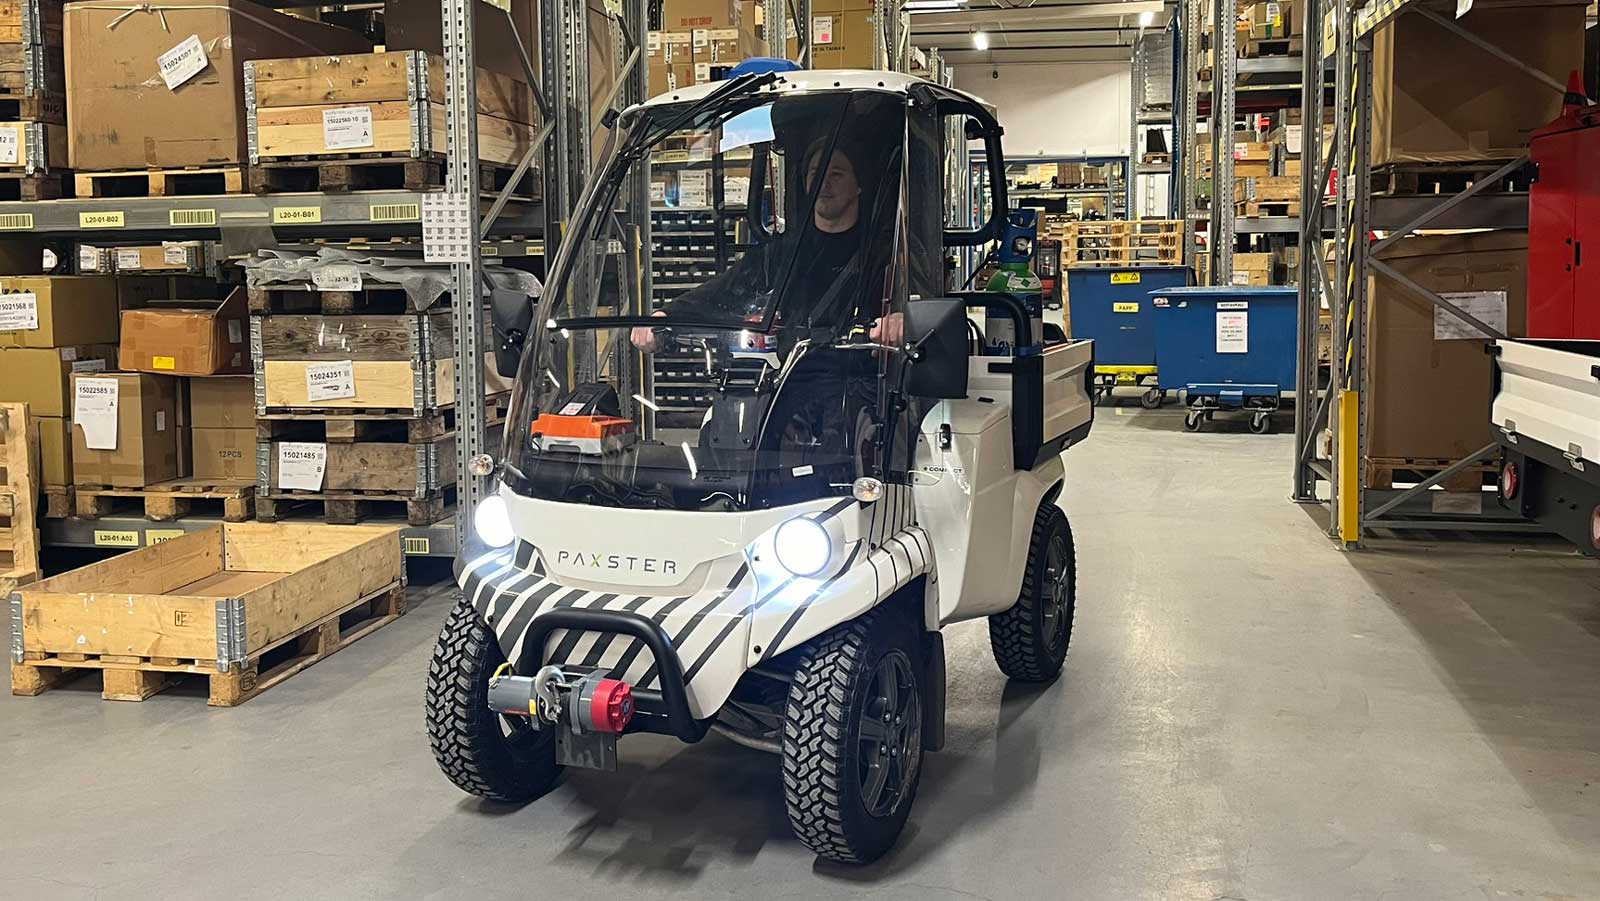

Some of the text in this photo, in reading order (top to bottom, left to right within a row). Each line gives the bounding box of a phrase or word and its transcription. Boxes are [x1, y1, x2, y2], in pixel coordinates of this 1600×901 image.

[164, 49, 193, 70] 15024507
[280, 210, 315, 219] L20-01-B01
[85, 215, 119, 224] L20-01-B02
[310, 371, 341, 381] 15024351
[79, 386, 108, 394] 15022585
[283, 451, 316, 459] 15021485
[558, 551, 677, 574] PAXSTER
